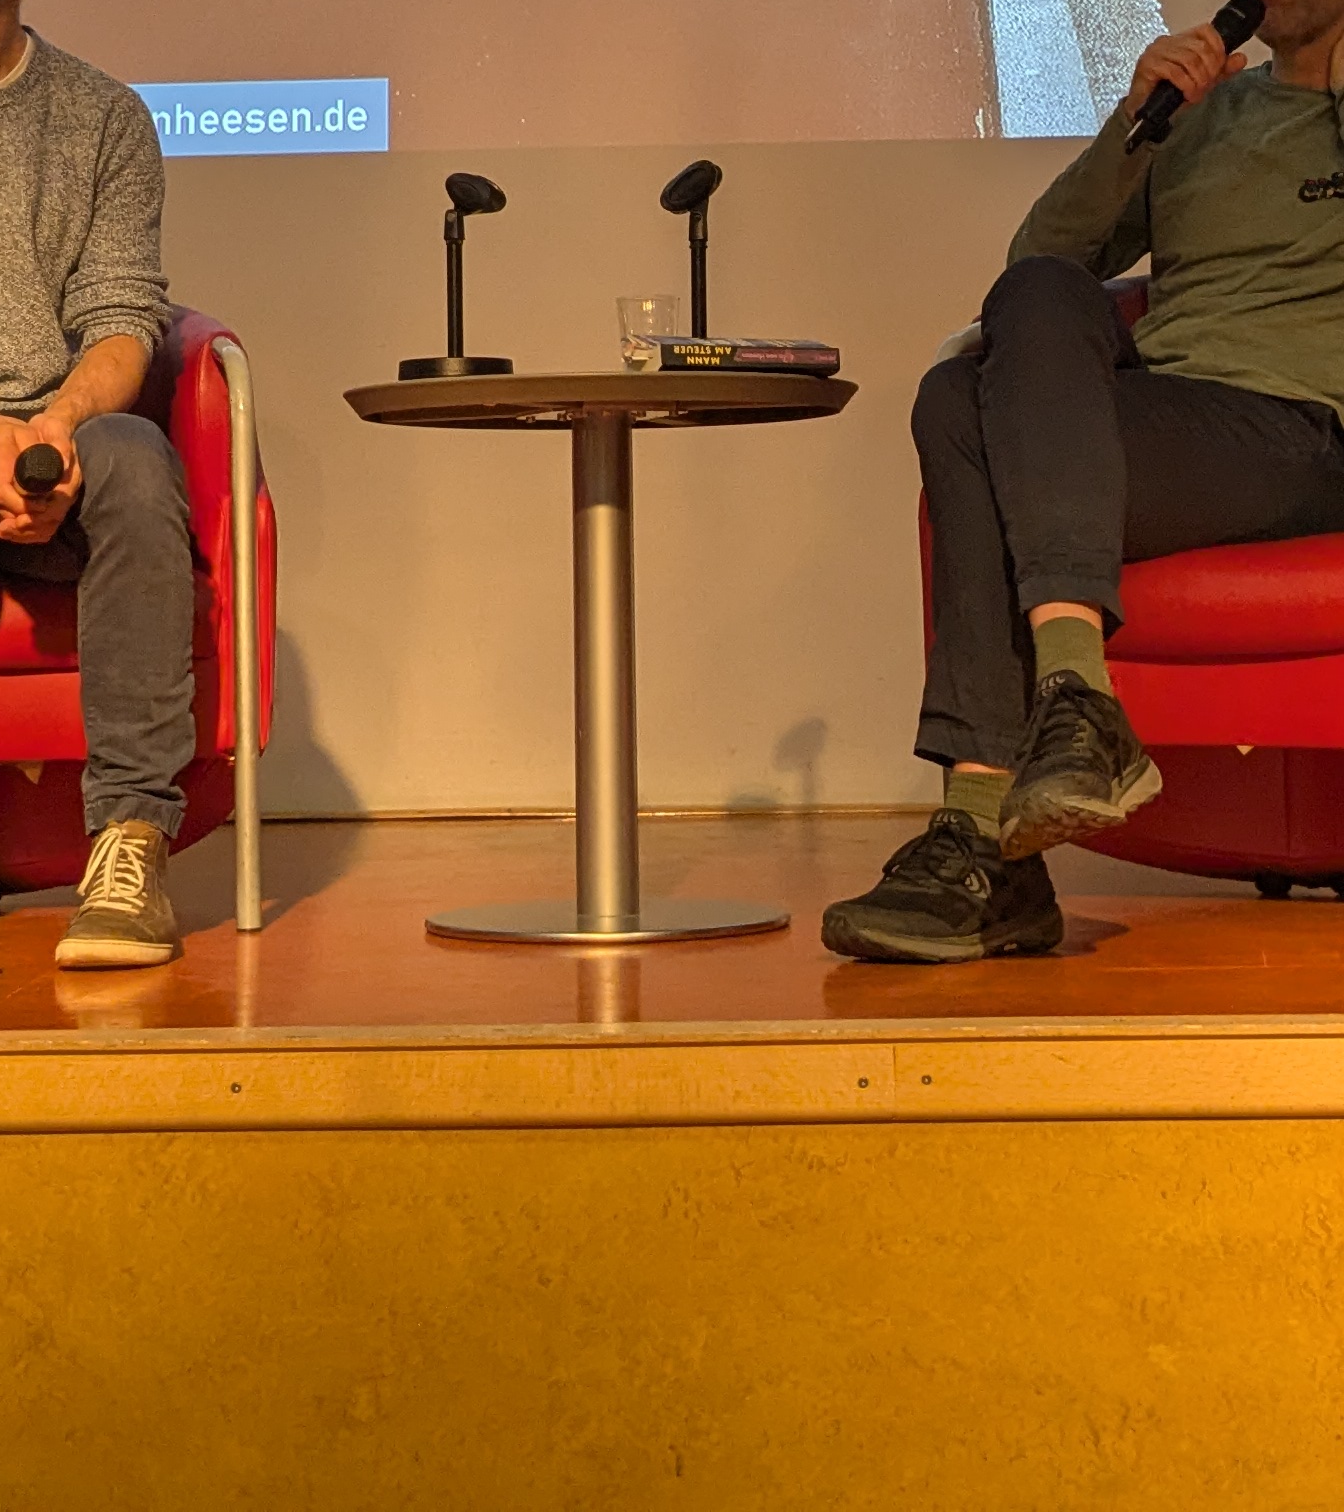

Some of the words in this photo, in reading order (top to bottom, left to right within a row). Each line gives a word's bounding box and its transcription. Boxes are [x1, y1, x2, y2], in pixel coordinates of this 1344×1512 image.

[673, 345, 712, 354] STEUER
[714, 346, 732, 355] AM
[686, 355, 720, 365] MANN
